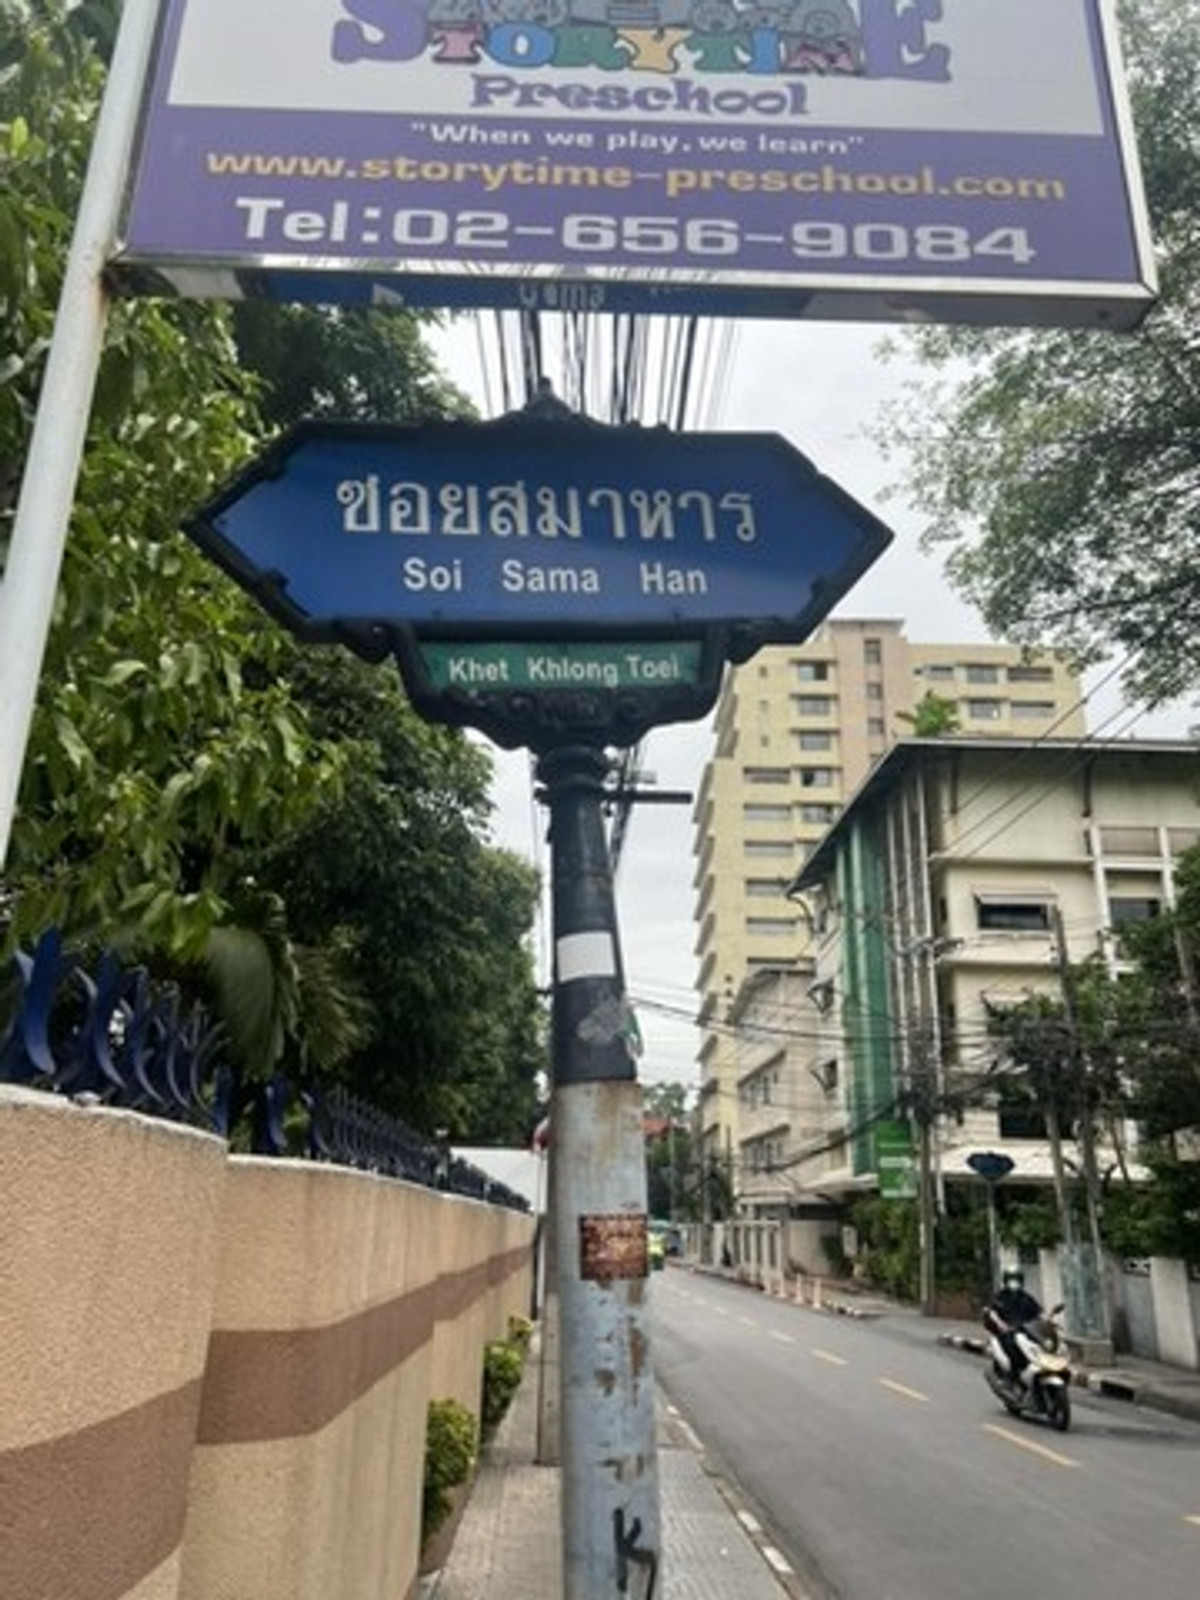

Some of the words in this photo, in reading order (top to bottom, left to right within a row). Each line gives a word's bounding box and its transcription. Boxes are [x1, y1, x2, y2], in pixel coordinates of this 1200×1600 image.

[470, 73, 808, 116] Preschool
[546, 132, 593, 148] we
[207, 153, 1065, 199] www.storytime-preschool.com
[337, 475, 755, 541] ซอยสมาหาร
[403, 557, 461, 591] Soi
[502, 559, 599, 592] Sama
[640, 561, 708, 593] Han
[449, 658, 508, 682] Khet
[527, 657, 618, 687] Khlong
[627, 655, 679, 678] Toei
